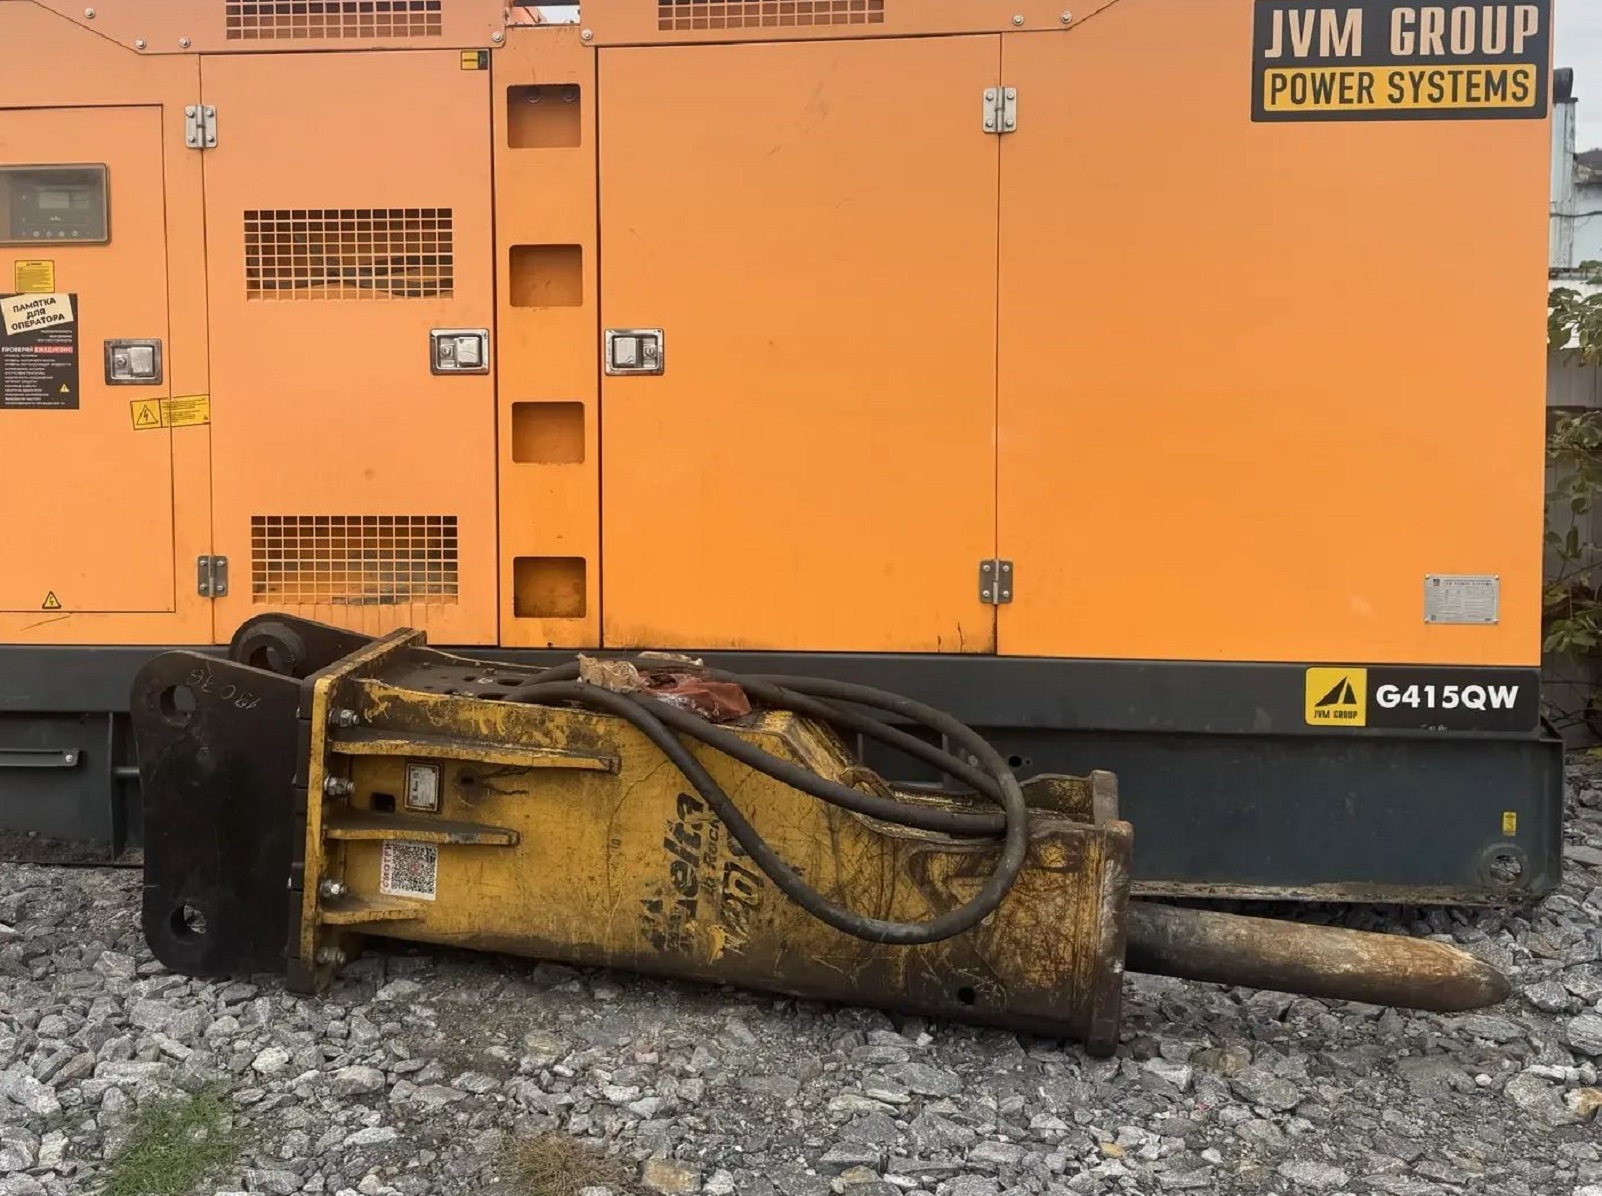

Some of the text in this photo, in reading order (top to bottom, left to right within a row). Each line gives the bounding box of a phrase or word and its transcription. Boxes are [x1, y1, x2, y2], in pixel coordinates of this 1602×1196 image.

[1264, 5, 1539, 58] JVM GROUP
[1270, 69, 1530, 106] POWER SYSTEMS
[12, 297, 57, 313] ПАМЯТКА
[26, 308, 46, 320] ДЛЯ
[11, 313, 65, 331] ОПЕРАТОРА
[1376, 684, 1519, 711] G415QW
[1314, 710, 1358, 719] JVM GROUP
